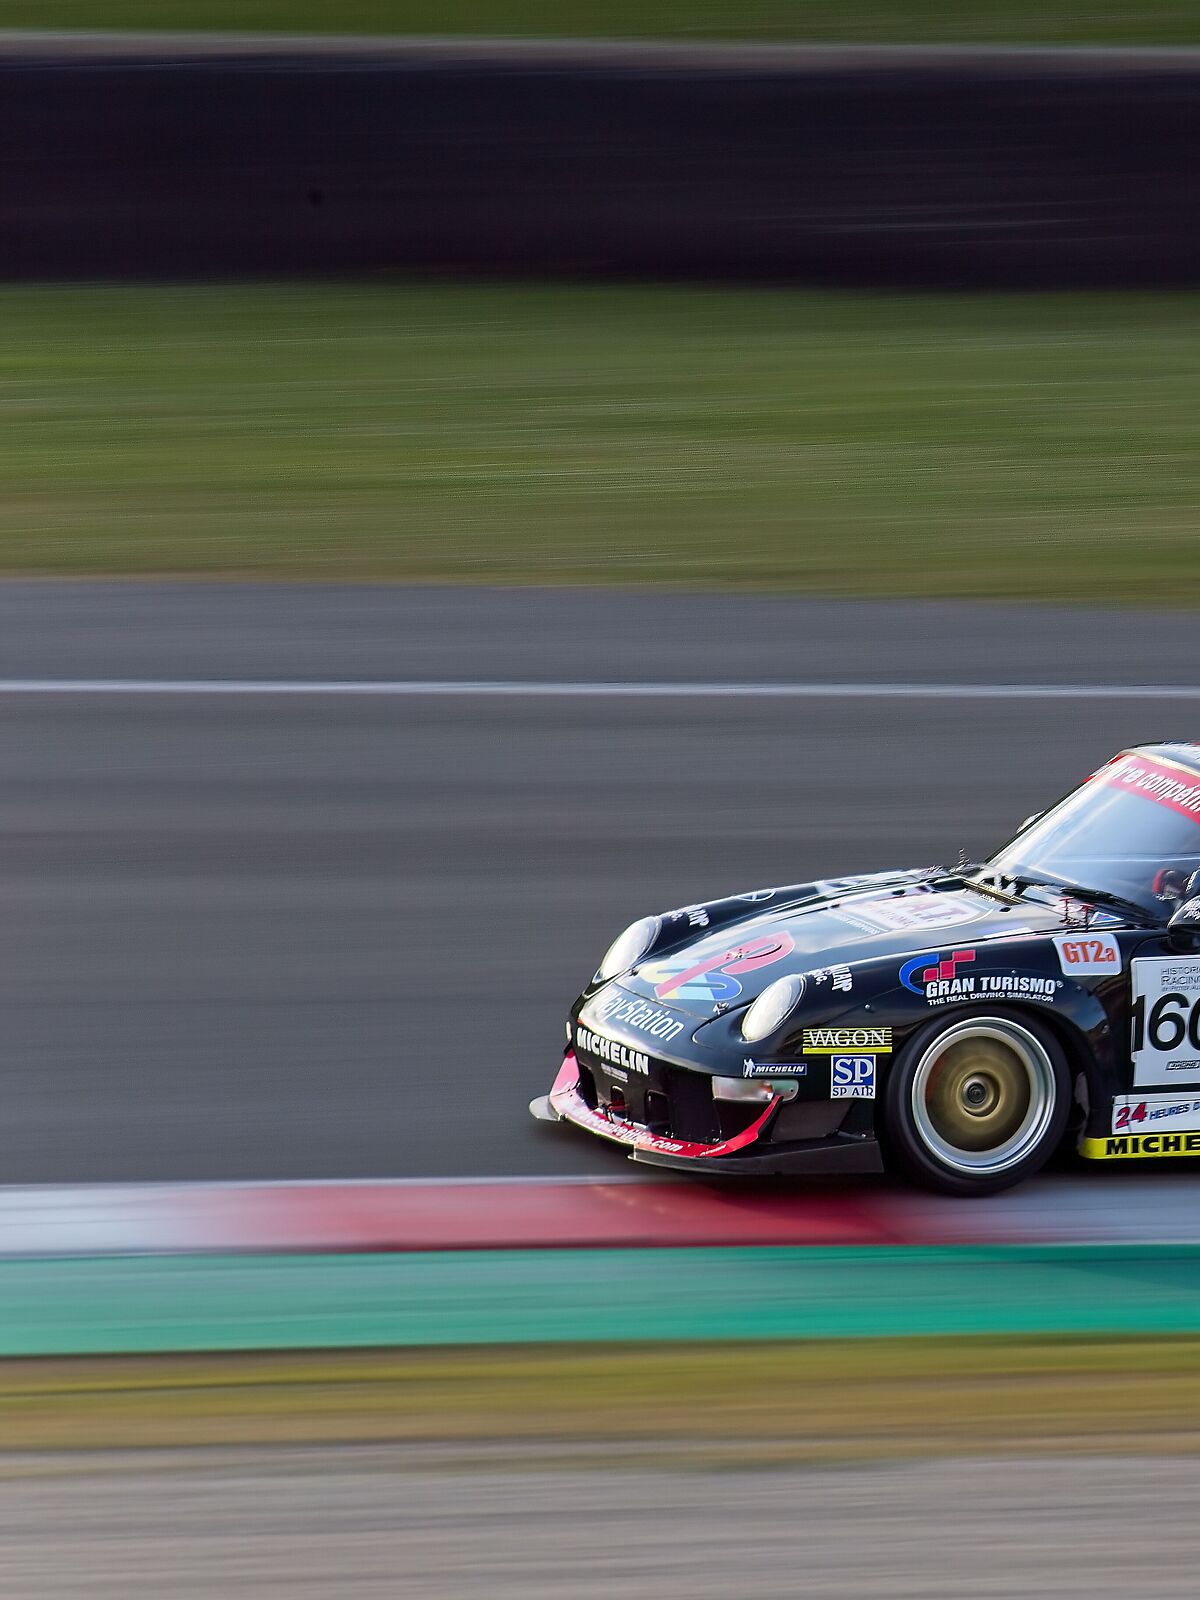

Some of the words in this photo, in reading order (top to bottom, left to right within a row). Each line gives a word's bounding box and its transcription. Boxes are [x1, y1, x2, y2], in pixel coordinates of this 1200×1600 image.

[1062, 939, 1116, 964] GT2a
[926, 978, 974, 998] GRAN
[928, 998, 945, 1006] THE
[946, 994, 969, 1003] REAL
[970, 991, 1005, 1000] DRIVING
[1007, 991, 1054, 1003] SIMULATOR
[808, 1029, 886, 1048] WAGON
[576, 1027, 649, 1076] MICHELIN
[755, 1065, 804, 1074] MICHELIN
[833, 1058, 874, 1085] SP
[832, 1086, 847, 1097] SP
[852, 1086, 874, 1097] AIR
[1115, 1102, 1148, 1129] 24
[1149, 1103, 1190, 1121] HEURES
